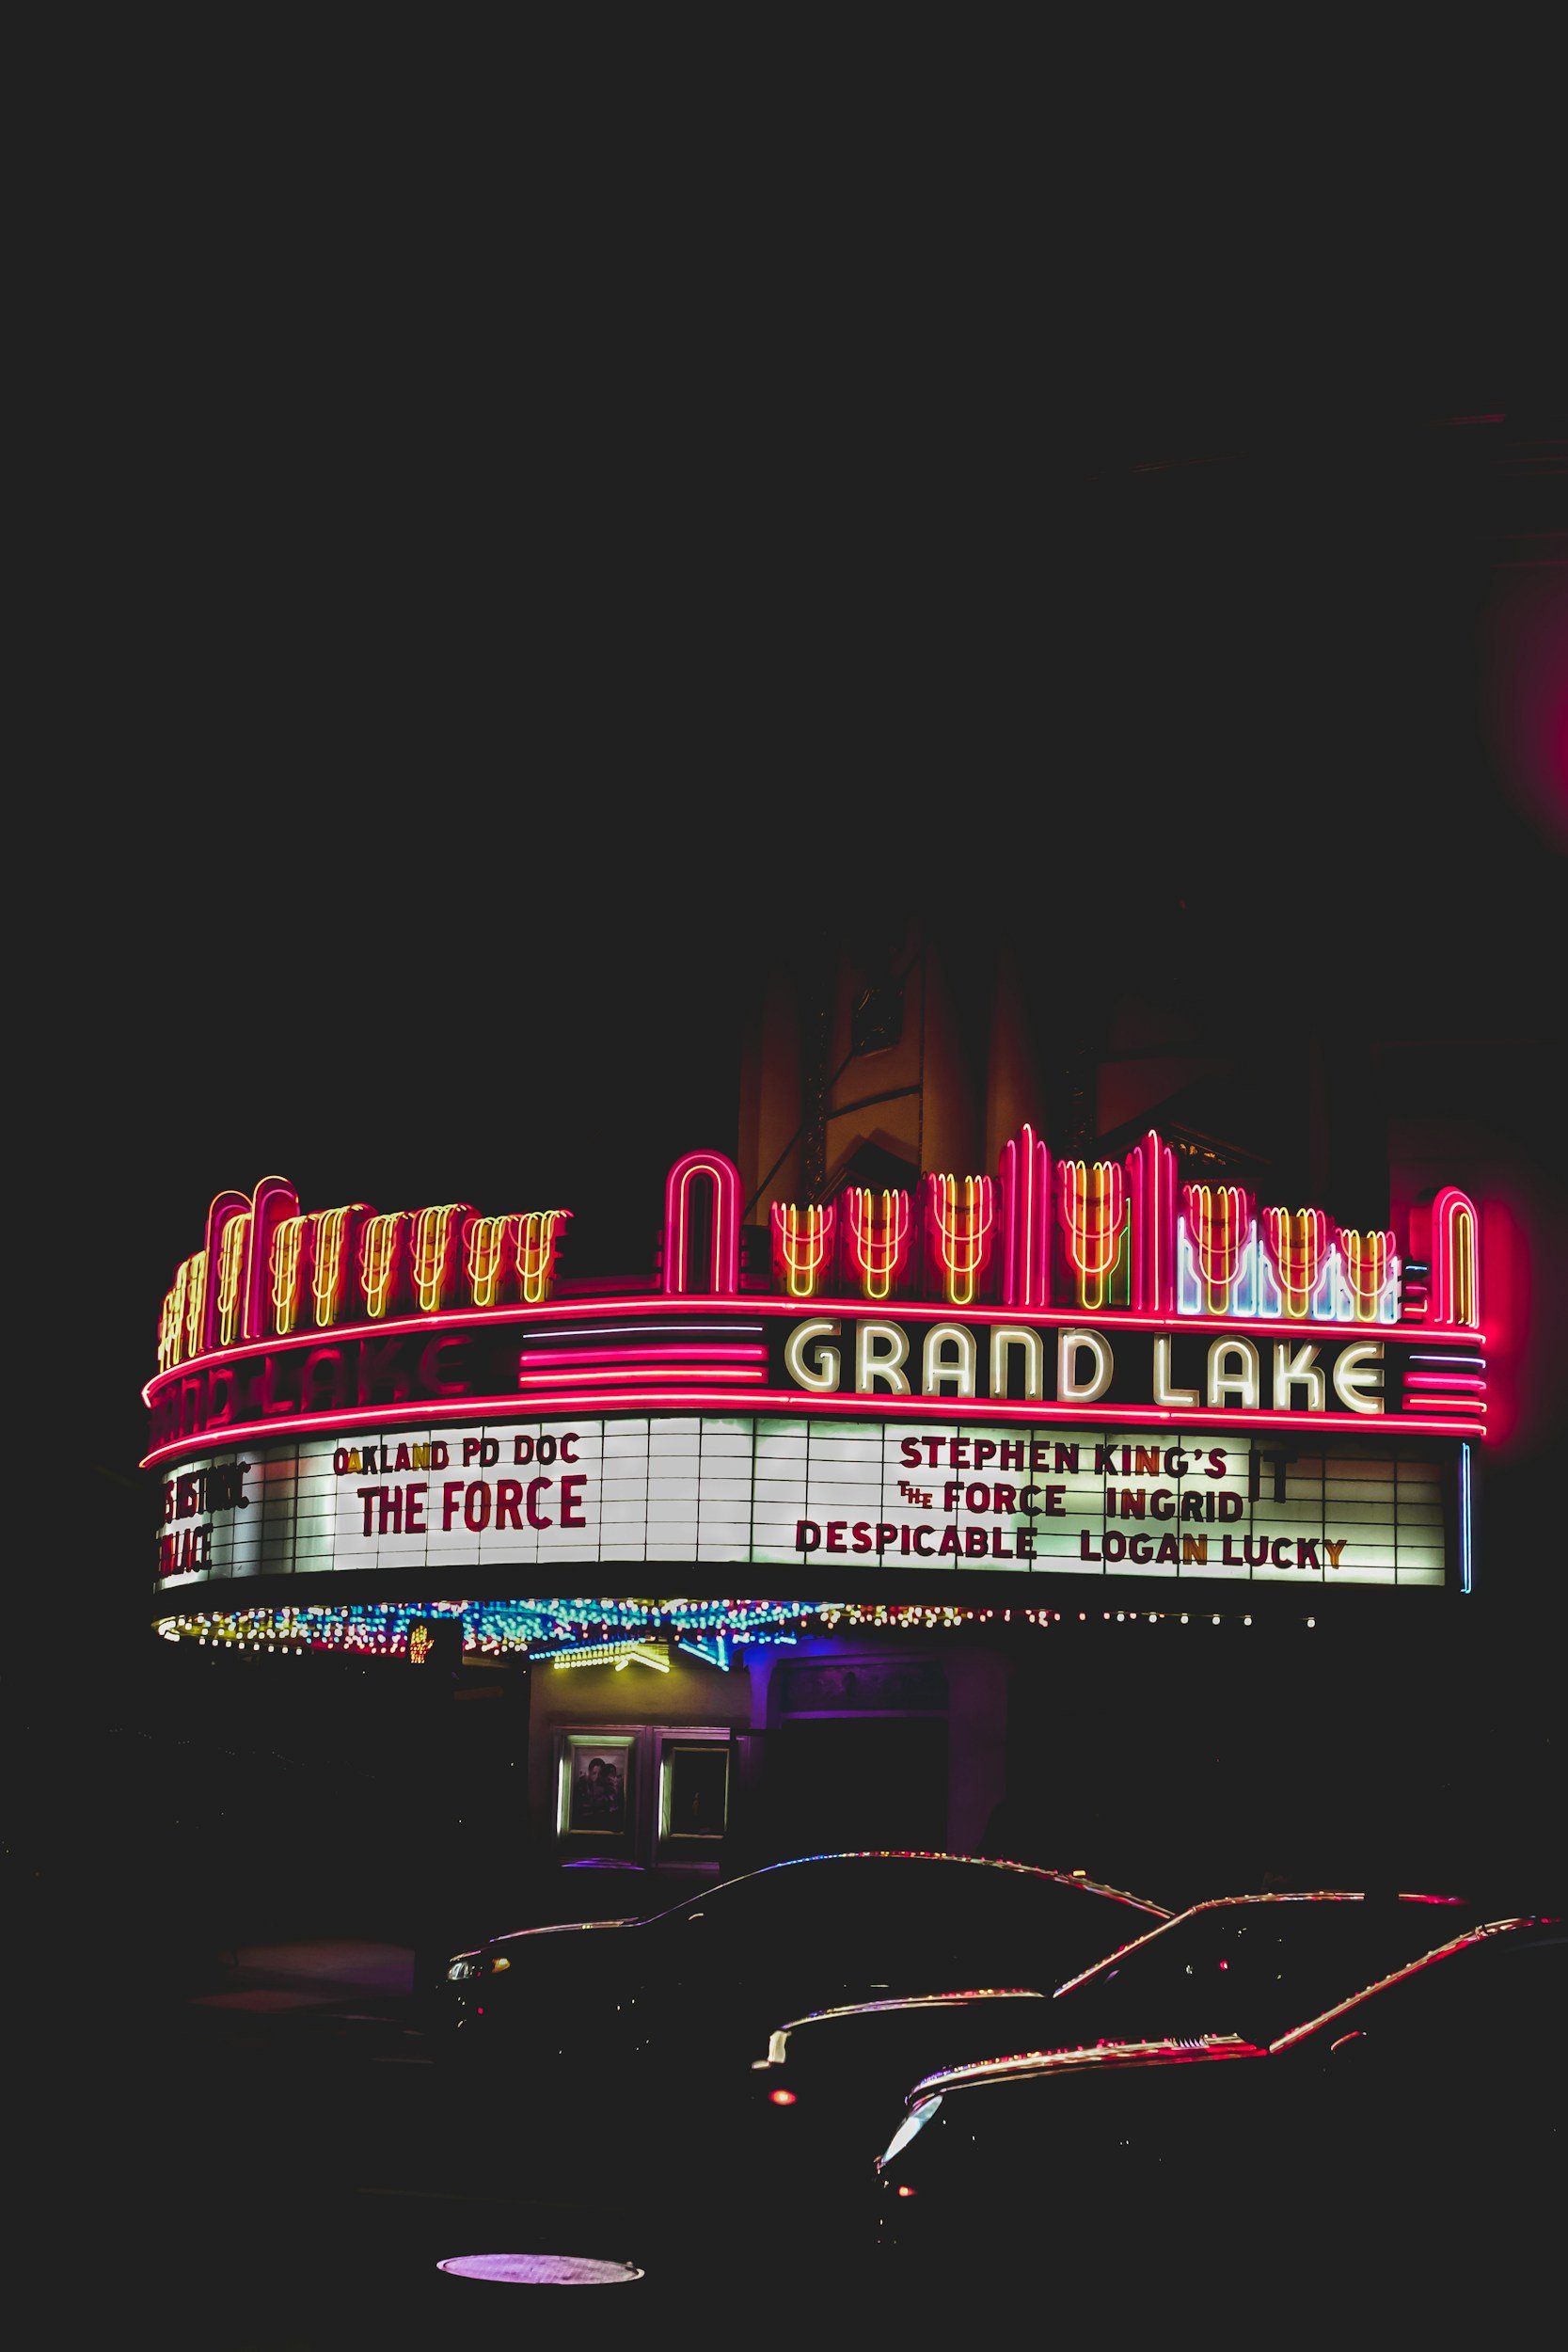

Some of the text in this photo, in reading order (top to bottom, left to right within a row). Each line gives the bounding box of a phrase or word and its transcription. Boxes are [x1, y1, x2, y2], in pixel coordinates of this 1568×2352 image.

[784, 1317, 1385, 1414] GRAND LAKE
[333, 1432, 579, 1475] OAKLAND PD DOC
[899, 1436, 1299, 1503] STEPHEN KING'S IT
[357, 1474, 587, 1536] THE FORCE
[897, 1480, 1243, 1523] THE FORCE INGRID
[795, 1519, 1347, 1569] DESPICABLE LOGAN LUCKY
